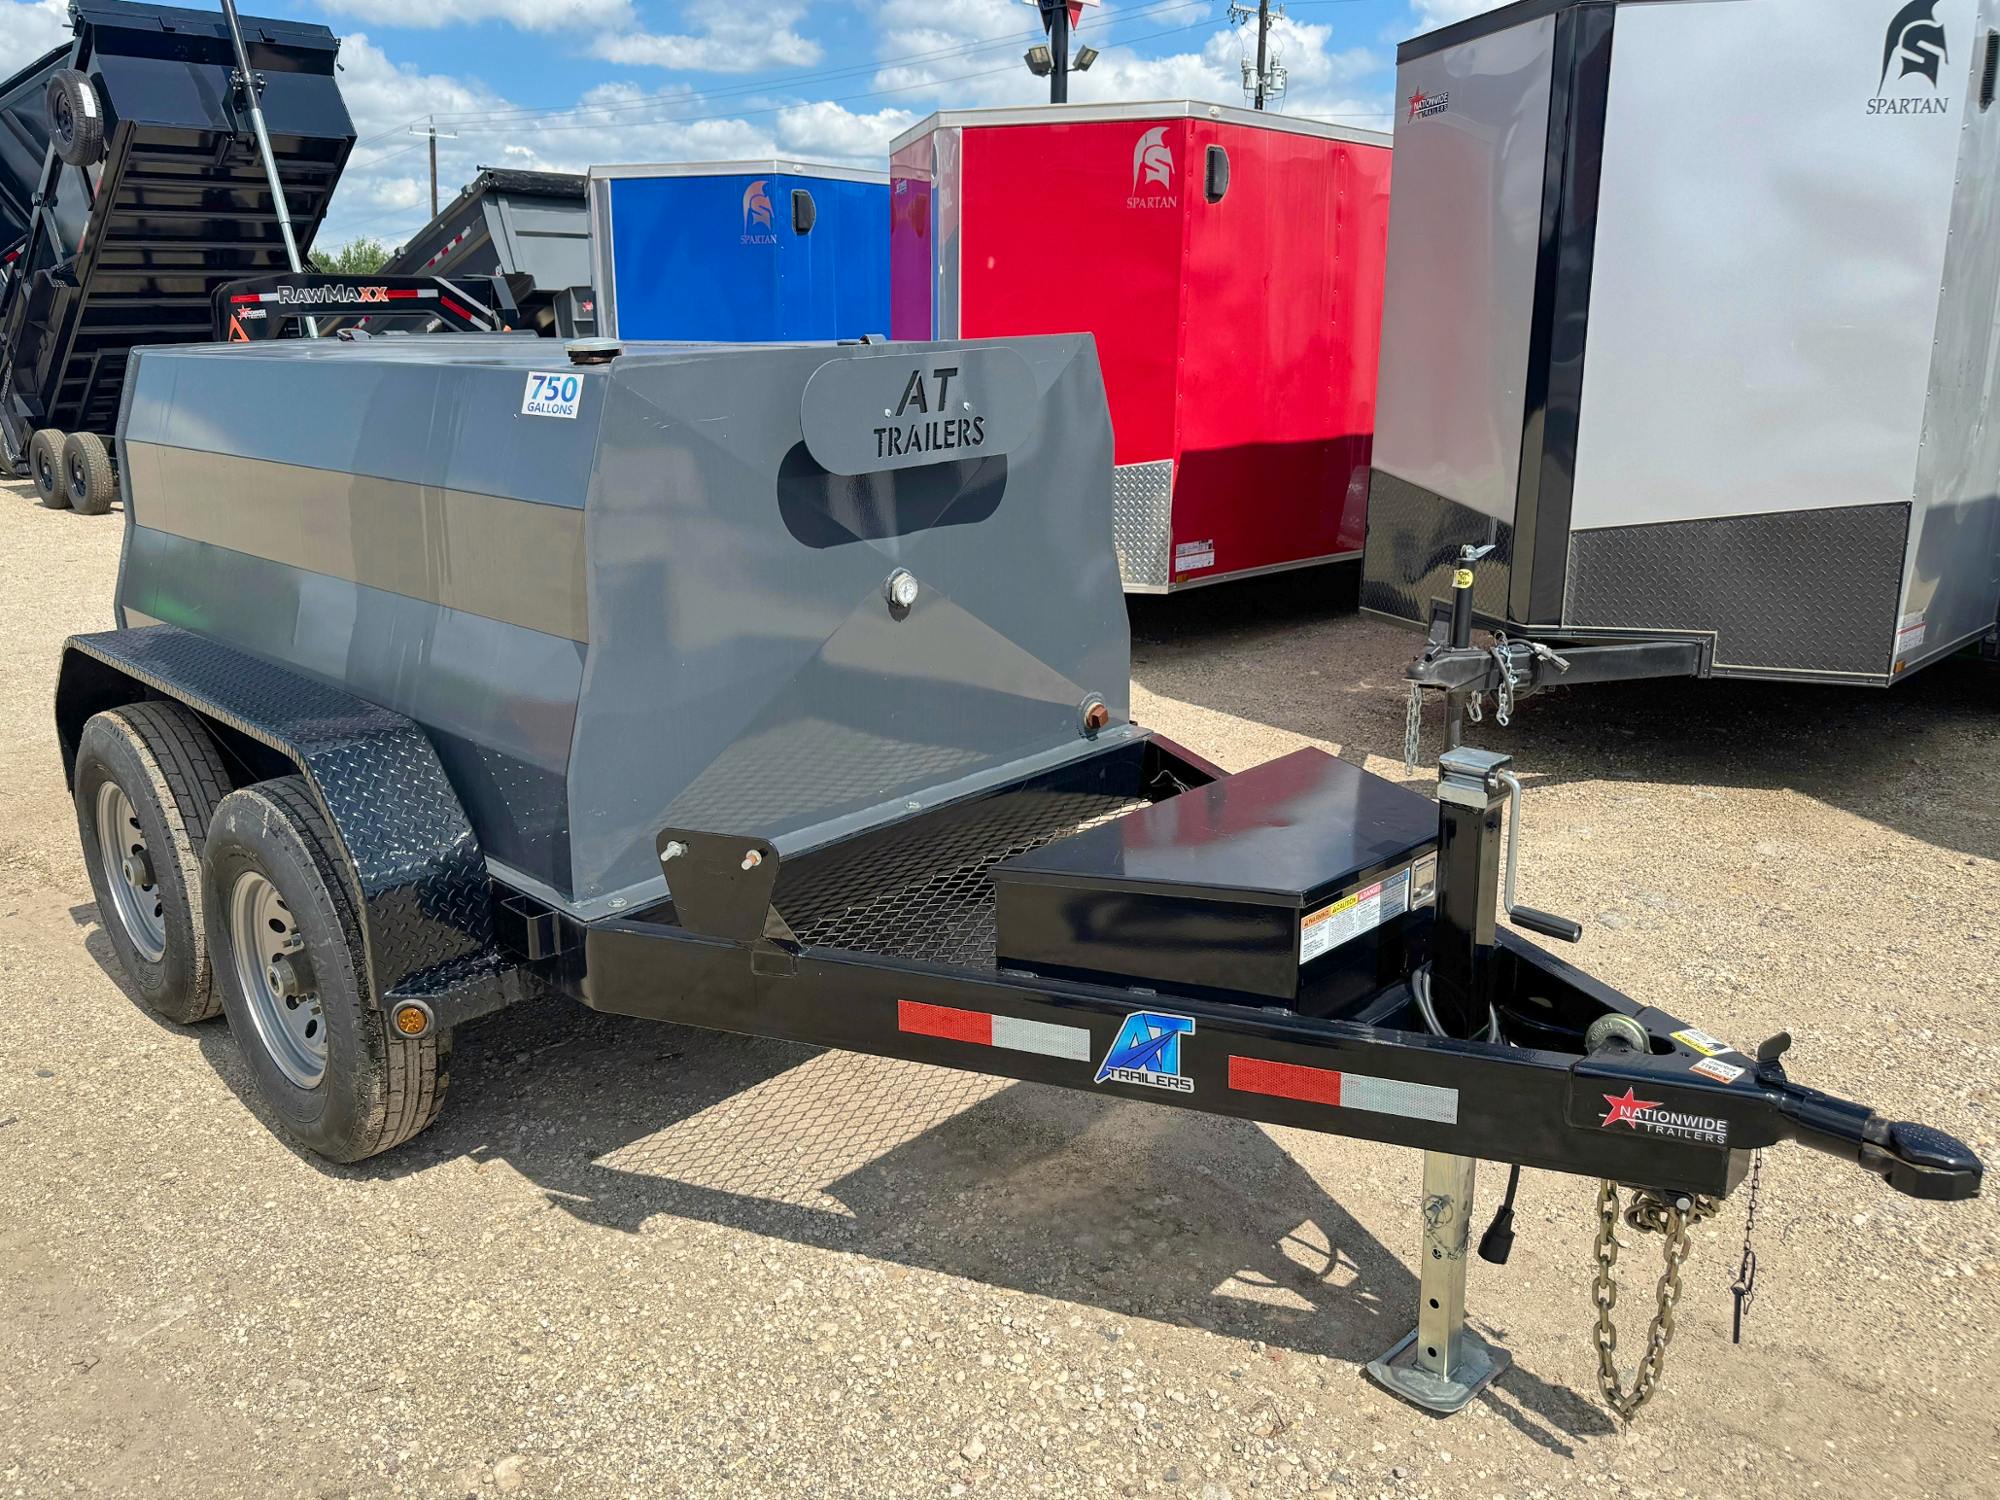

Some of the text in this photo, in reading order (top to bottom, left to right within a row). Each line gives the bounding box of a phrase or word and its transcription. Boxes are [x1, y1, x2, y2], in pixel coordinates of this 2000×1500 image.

[1866, 97, 1950, 115] SPARTAN
[1126, 195, 1177, 208] SPARTAN
[740, 234, 777, 245] SPARTAN
[531, 375, 578, 403] 750
[895, 367, 958, 416] AT
[527, 402, 573, 415] GALLONS
[873, 416, 985, 458] TRAILERS
[1097, 1013, 1193, 1081] AT
[1107, 1067, 1192, 1091] TRAILERS
[1619, 1105, 1728, 1133] NATIONWIDE
[1645, 1124, 1726, 1144] TRAILERS
